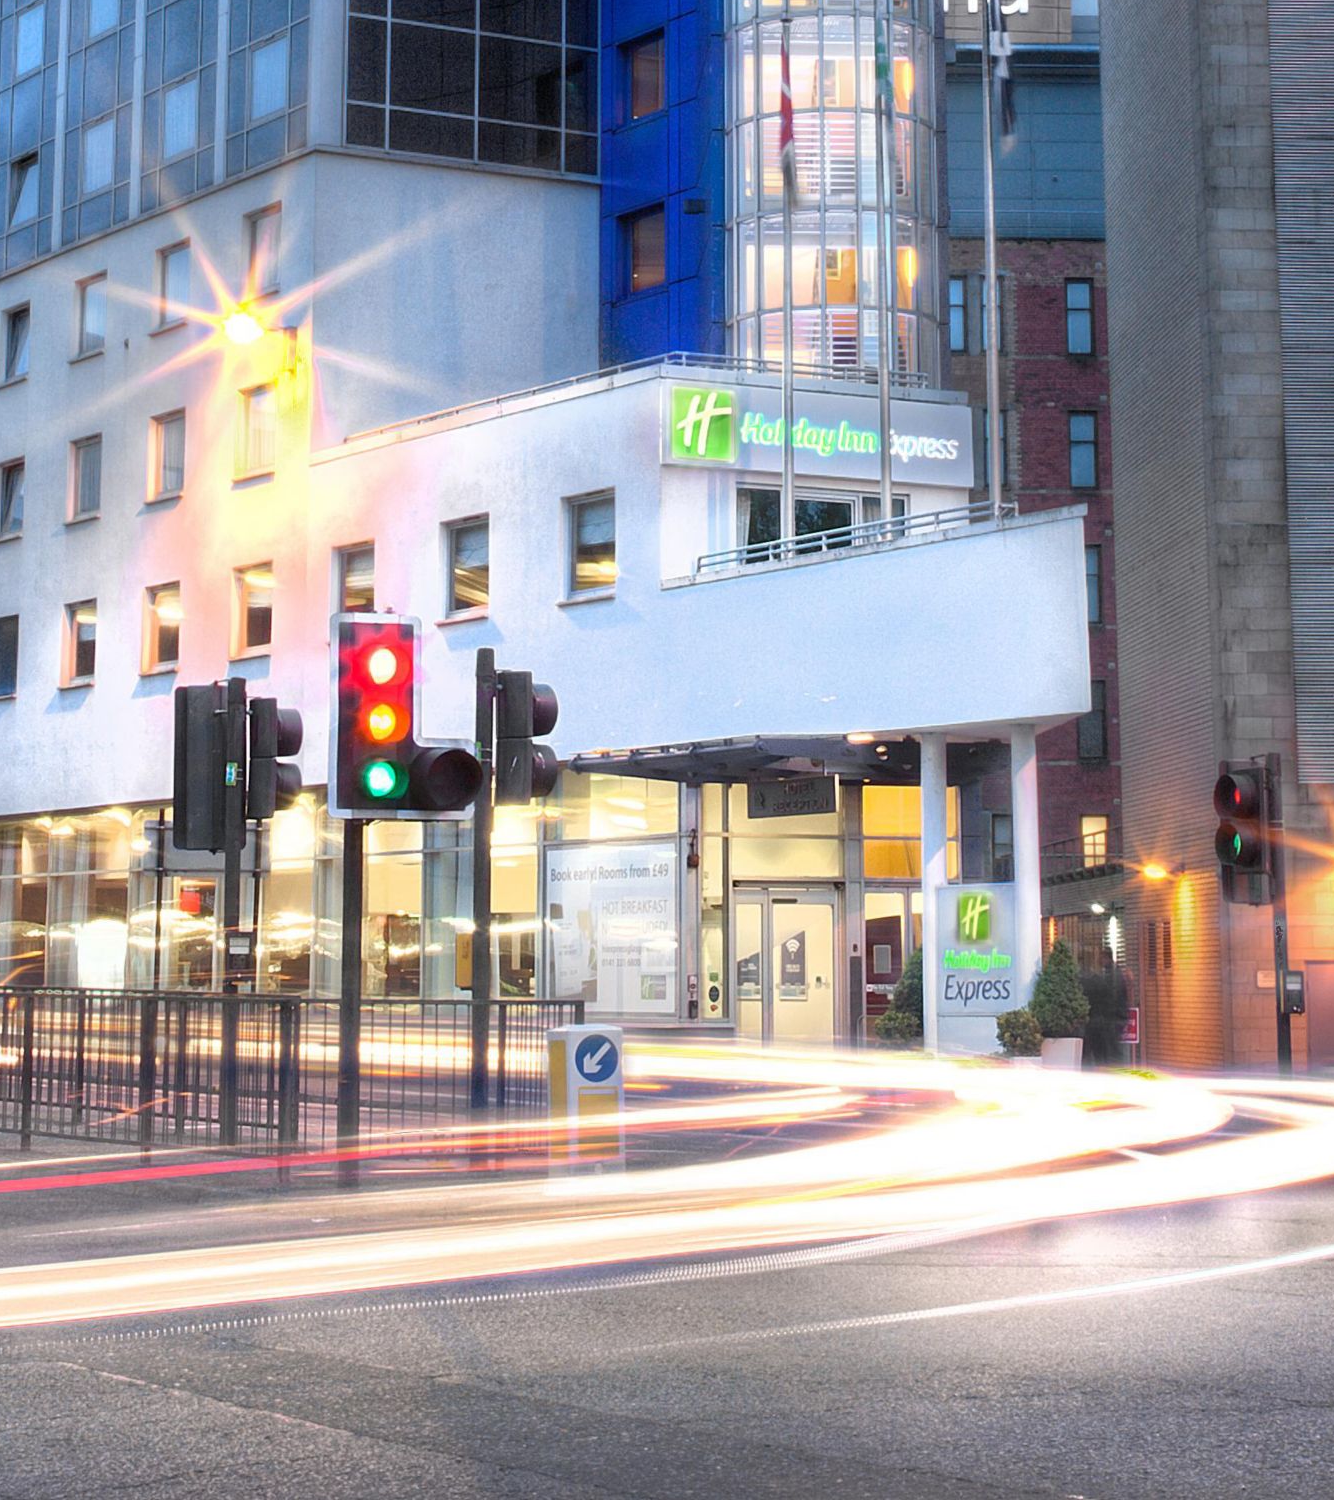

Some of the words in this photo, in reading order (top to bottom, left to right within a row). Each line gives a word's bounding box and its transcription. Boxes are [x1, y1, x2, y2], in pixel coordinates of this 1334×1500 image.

[740, 411, 837, 457] Holday
[838, 420, 878, 454] Inn
[550, 867, 572, 882] Book
[598, 866, 628, 881] Rooms
[629, 863, 651, 878] from
[652, 862, 669, 877] £49
[621, 899, 669, 915] BREAKFAST
[943, 949, 990, 974] Holiday
[991, 947, 1012, 969] Inn
[944, 974, 1011, 1007] Express
